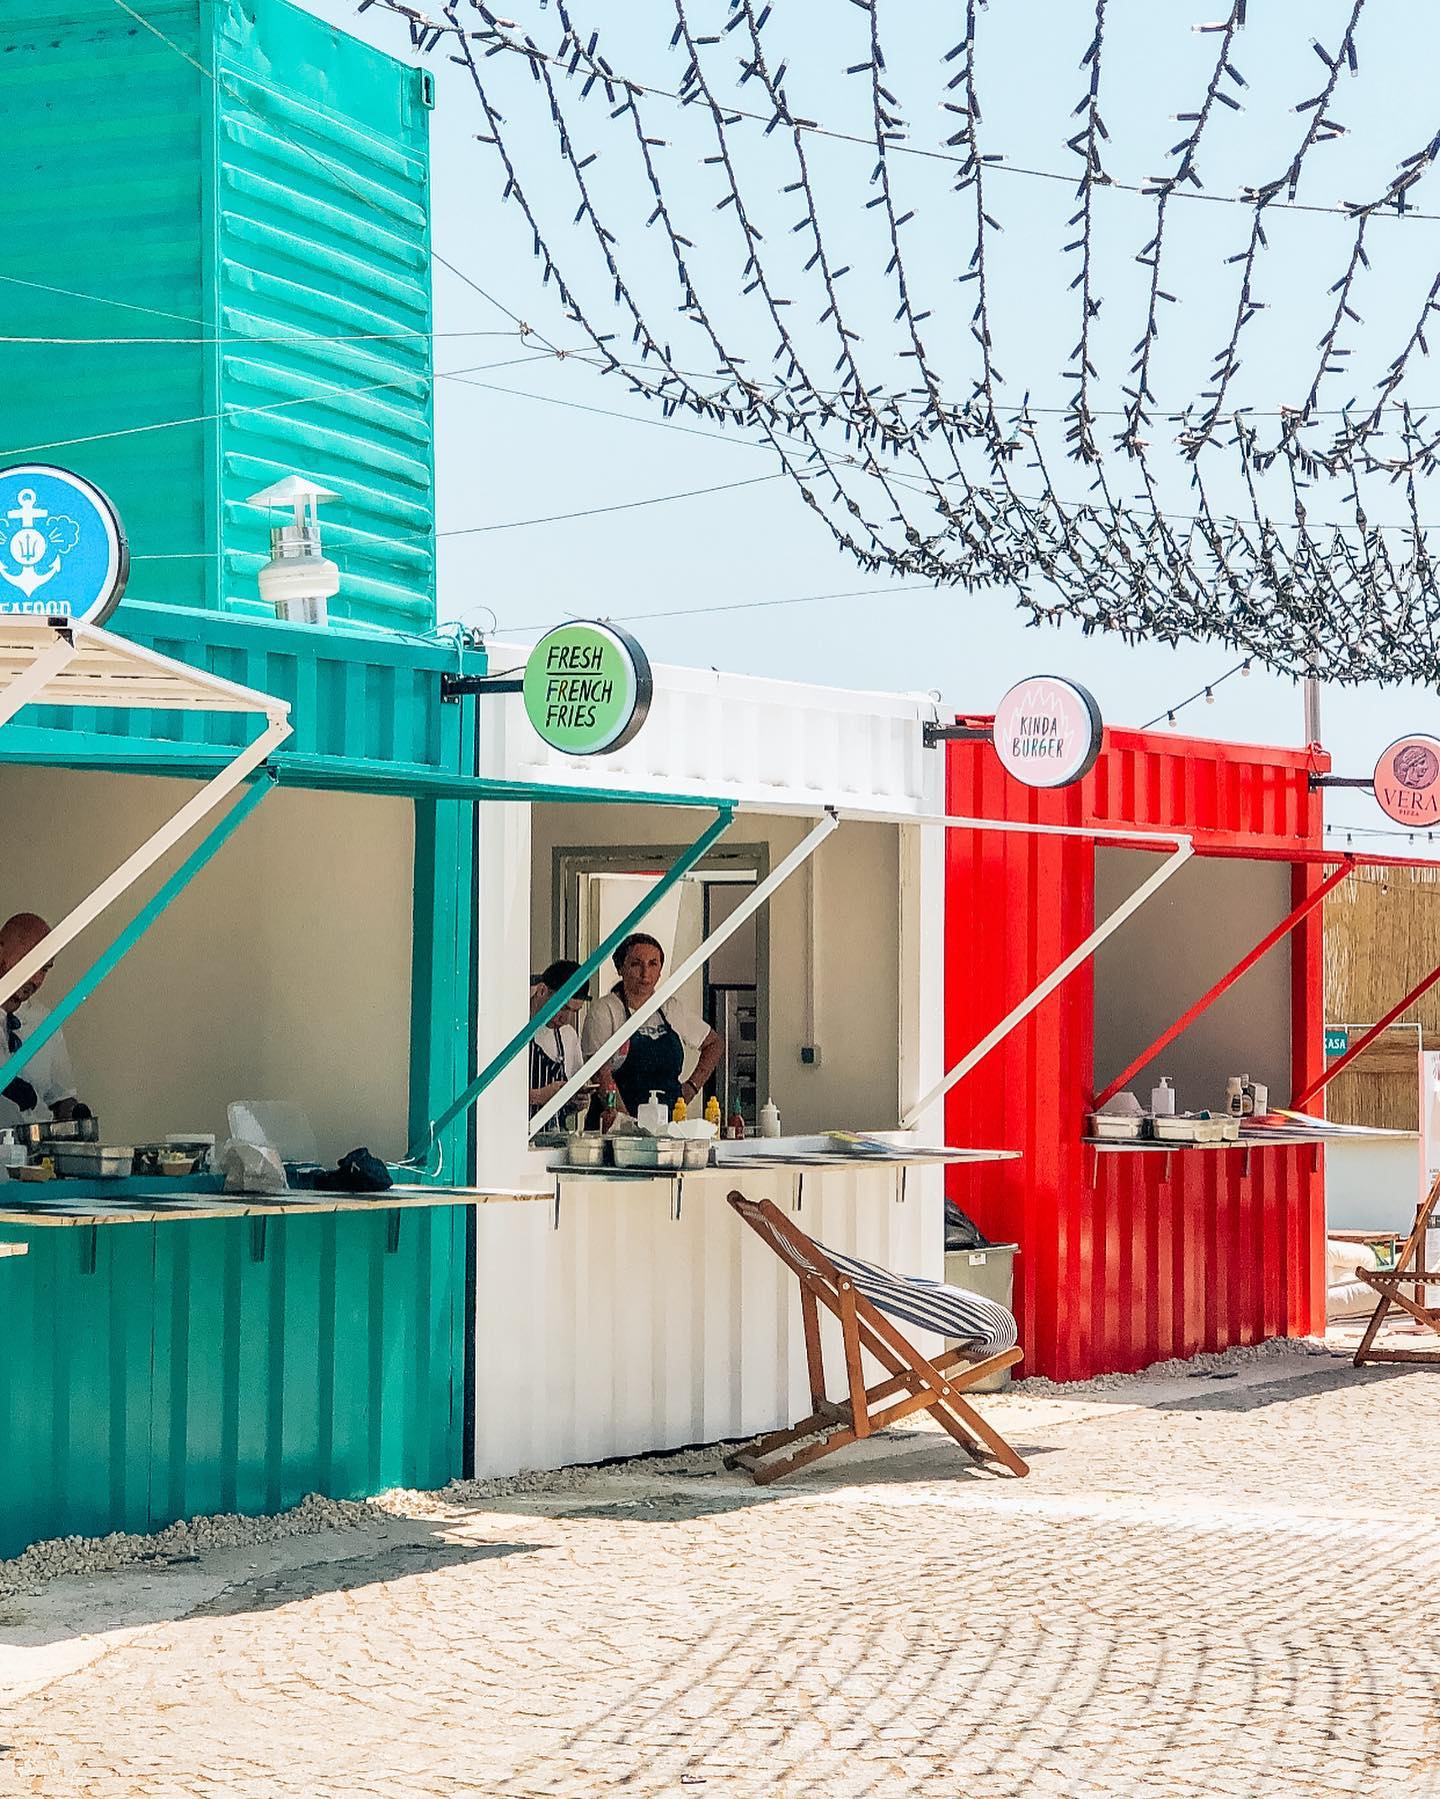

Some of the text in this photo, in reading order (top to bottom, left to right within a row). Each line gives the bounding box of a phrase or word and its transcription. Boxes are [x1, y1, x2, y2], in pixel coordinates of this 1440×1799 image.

[0, 600, 71, 616] EAFOOD
[546, 645, 604, 670] FRESH
[546, 679, 613, 704] FRENCH
[545, 704, 597, 728] FRIES
[1020, 716, 1057, 736] KINDA
[1012, 737, 1064, 758] BURGER
[1384, 788, 1438, 812] VERA
